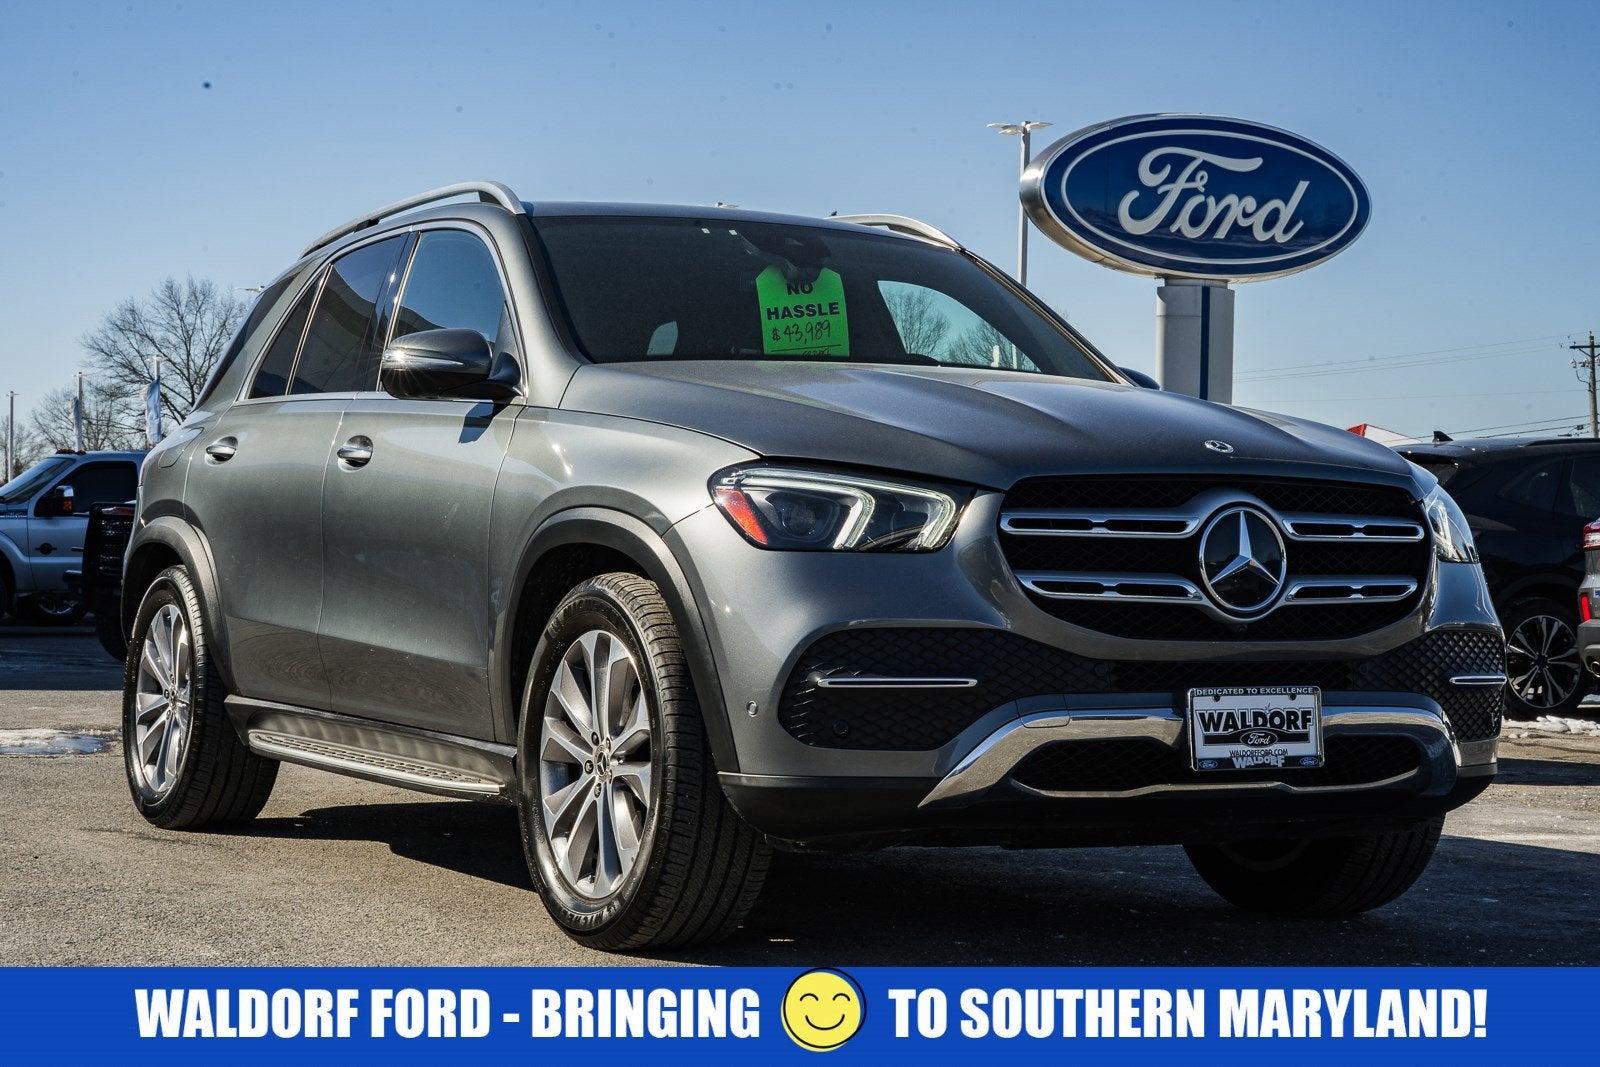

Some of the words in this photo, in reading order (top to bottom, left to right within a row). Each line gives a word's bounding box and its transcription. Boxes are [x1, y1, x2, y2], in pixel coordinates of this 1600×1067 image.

[1118, 147, 1310, 244] Ford
[786, 281, 814, 295] NO
[766, 301, 840, 320] HASSLE
[1196, 687, 1244, 696] DEDICATED
[1197, 709, 1313, 733] WALDORF
[1247, 731, 1271, 745] Ford
[1232, 756, 1286, 769] WALDORF
